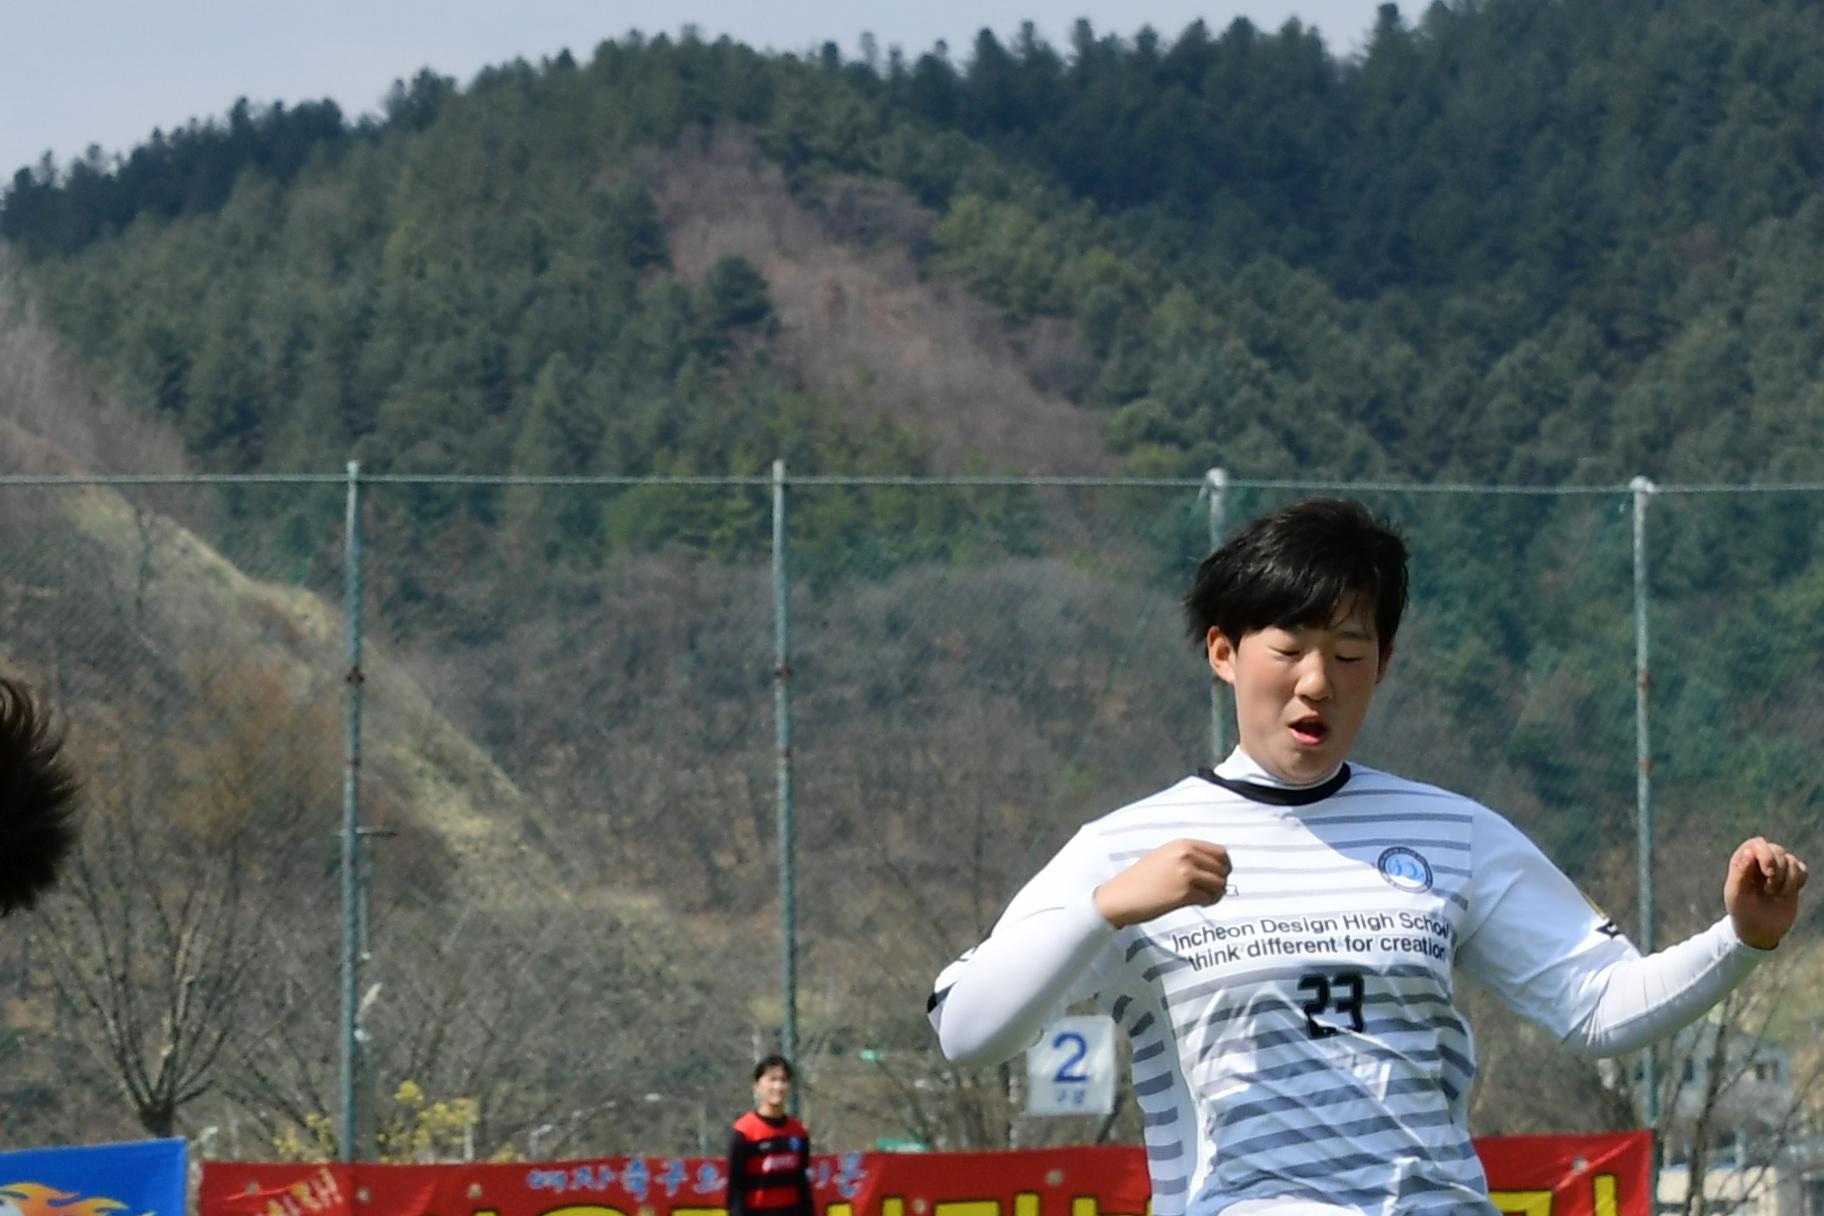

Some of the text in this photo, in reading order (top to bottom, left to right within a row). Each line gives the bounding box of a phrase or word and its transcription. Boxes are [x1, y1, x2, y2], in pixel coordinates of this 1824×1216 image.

[1171, 920, 1255, 951] Incheon
[1260, 916, 1338, 936] Design
[1342, 912, 1395, 932] High
[1187, 944, 1241, 973] think
[1247, 936, 1337, 958] different
[1343, 935, 1373, 953] for
[1297, 971, 1365, 1038] 23
[1053, 1033, 1087, 1082] 2
